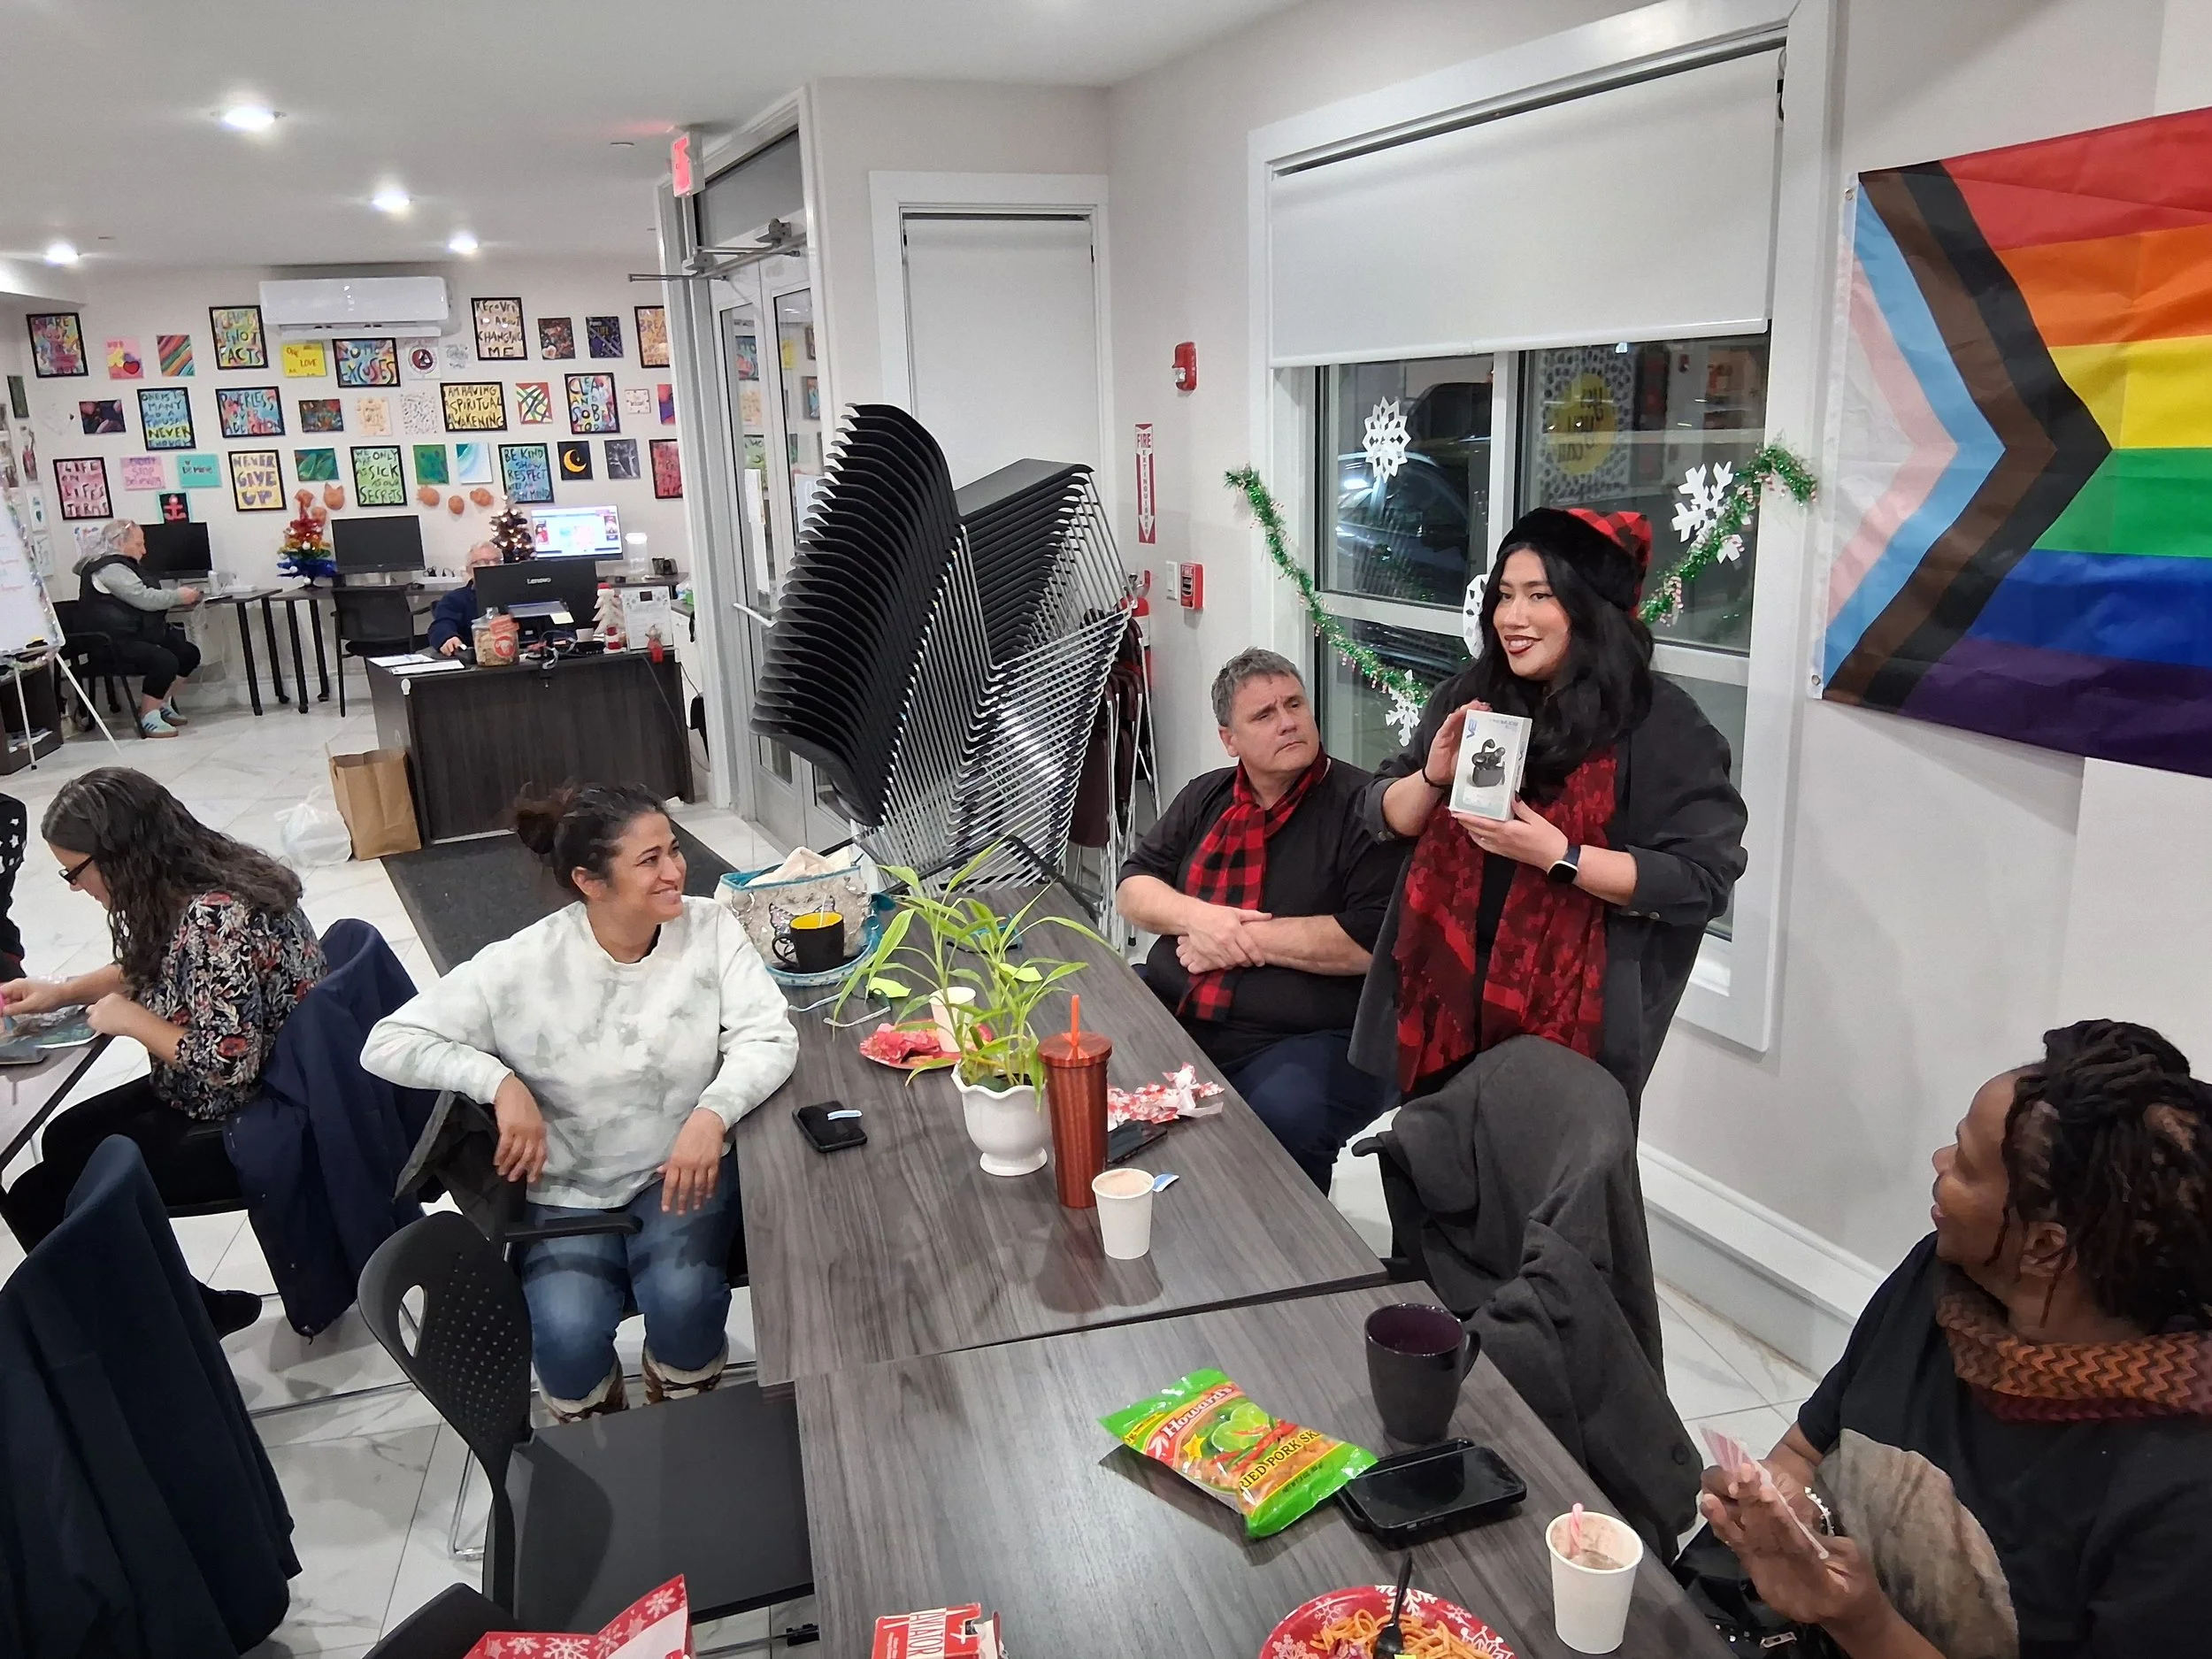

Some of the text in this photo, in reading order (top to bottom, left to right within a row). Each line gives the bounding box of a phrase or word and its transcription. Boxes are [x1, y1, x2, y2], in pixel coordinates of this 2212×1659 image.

[478, 330, 525, 344] CHANGING
[219, 345, 261, 364] FACTS
[488, 346, 513, 357] ME
[299, 358, 318, 368] LOVE
[341, 357, 395, 384] EXCUSES
[462, 386, 496, 396] HAVING
[148, 399, 181, 411] MANY
[449, 396, 502, 415] SPIRITUAL
[572, 402, 613, 423] SOBER
[448, 412, 504, 429] AWAKENING
[148, 425, 192, 439] NEVER
[1137, 434, 1151, 448] FIRE
[233, 454, 276, 468] NEVER
[373, 449, 398, 461] ONLY
[504, 448, 543, 462] BE KIND
[65, 463, 98, 472] LIFE
[369, 464, 399, 480] SICK
[237, 471, 277, 488] GIVE
[507, 469, 547, 482] RESPECT
[242, 490, 273, 505] UP
[359, 486, 403, 503] SECRETS
[67, 503, 108, 517] TERMS
[1182, 566, 1194, 576] FIRE
[1266, 1440, 1302, 1466] PORK
[908, 1612, 944, 1656] AVIATOR
